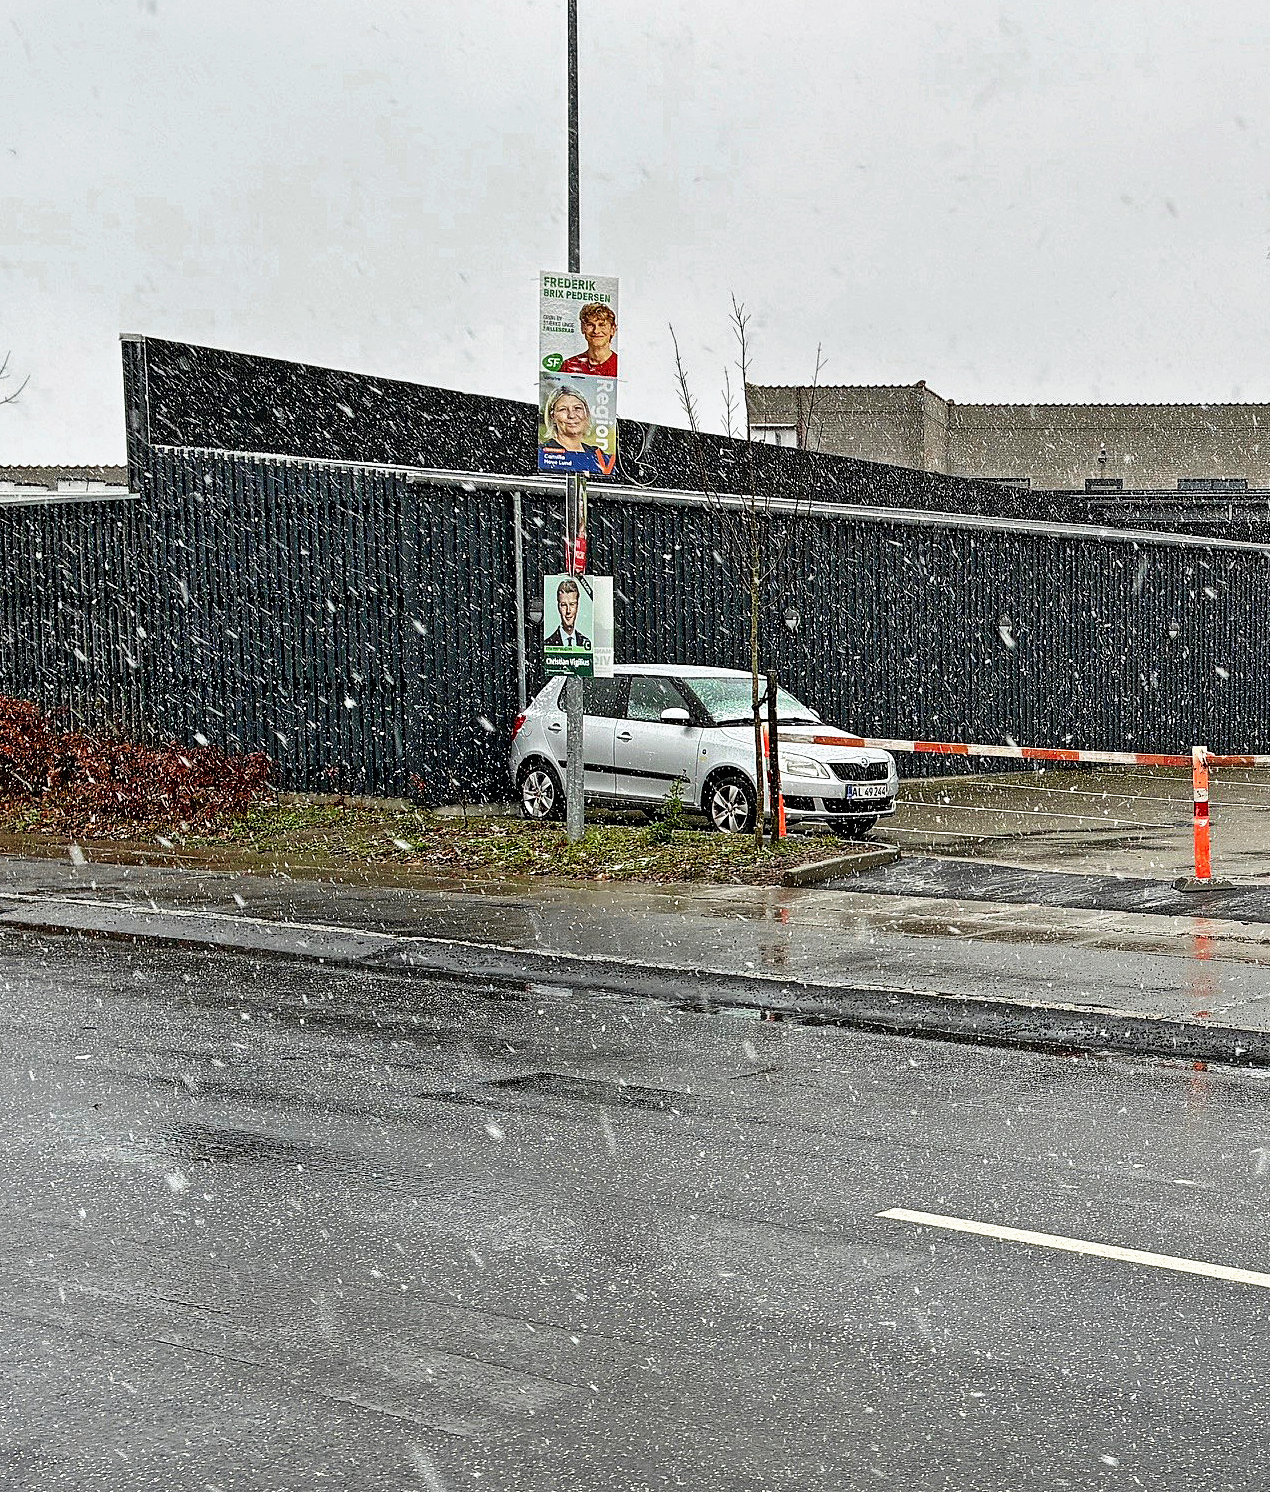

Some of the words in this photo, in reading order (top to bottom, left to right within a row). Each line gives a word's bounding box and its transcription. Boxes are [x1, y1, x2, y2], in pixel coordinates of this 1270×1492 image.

[543, 277, 596, 291] FREDERIK
[543, 289, 564, 298] BRIX
[566, 290, 611, 303] PEDERSEN
[546, 357, 560, 368] SF
[591, 380, 614, 451] Region
[546, 657, 570, 666] Christian
[570, 658, 590, 668] Vigilius
[852, 787, 863, 797] AL
